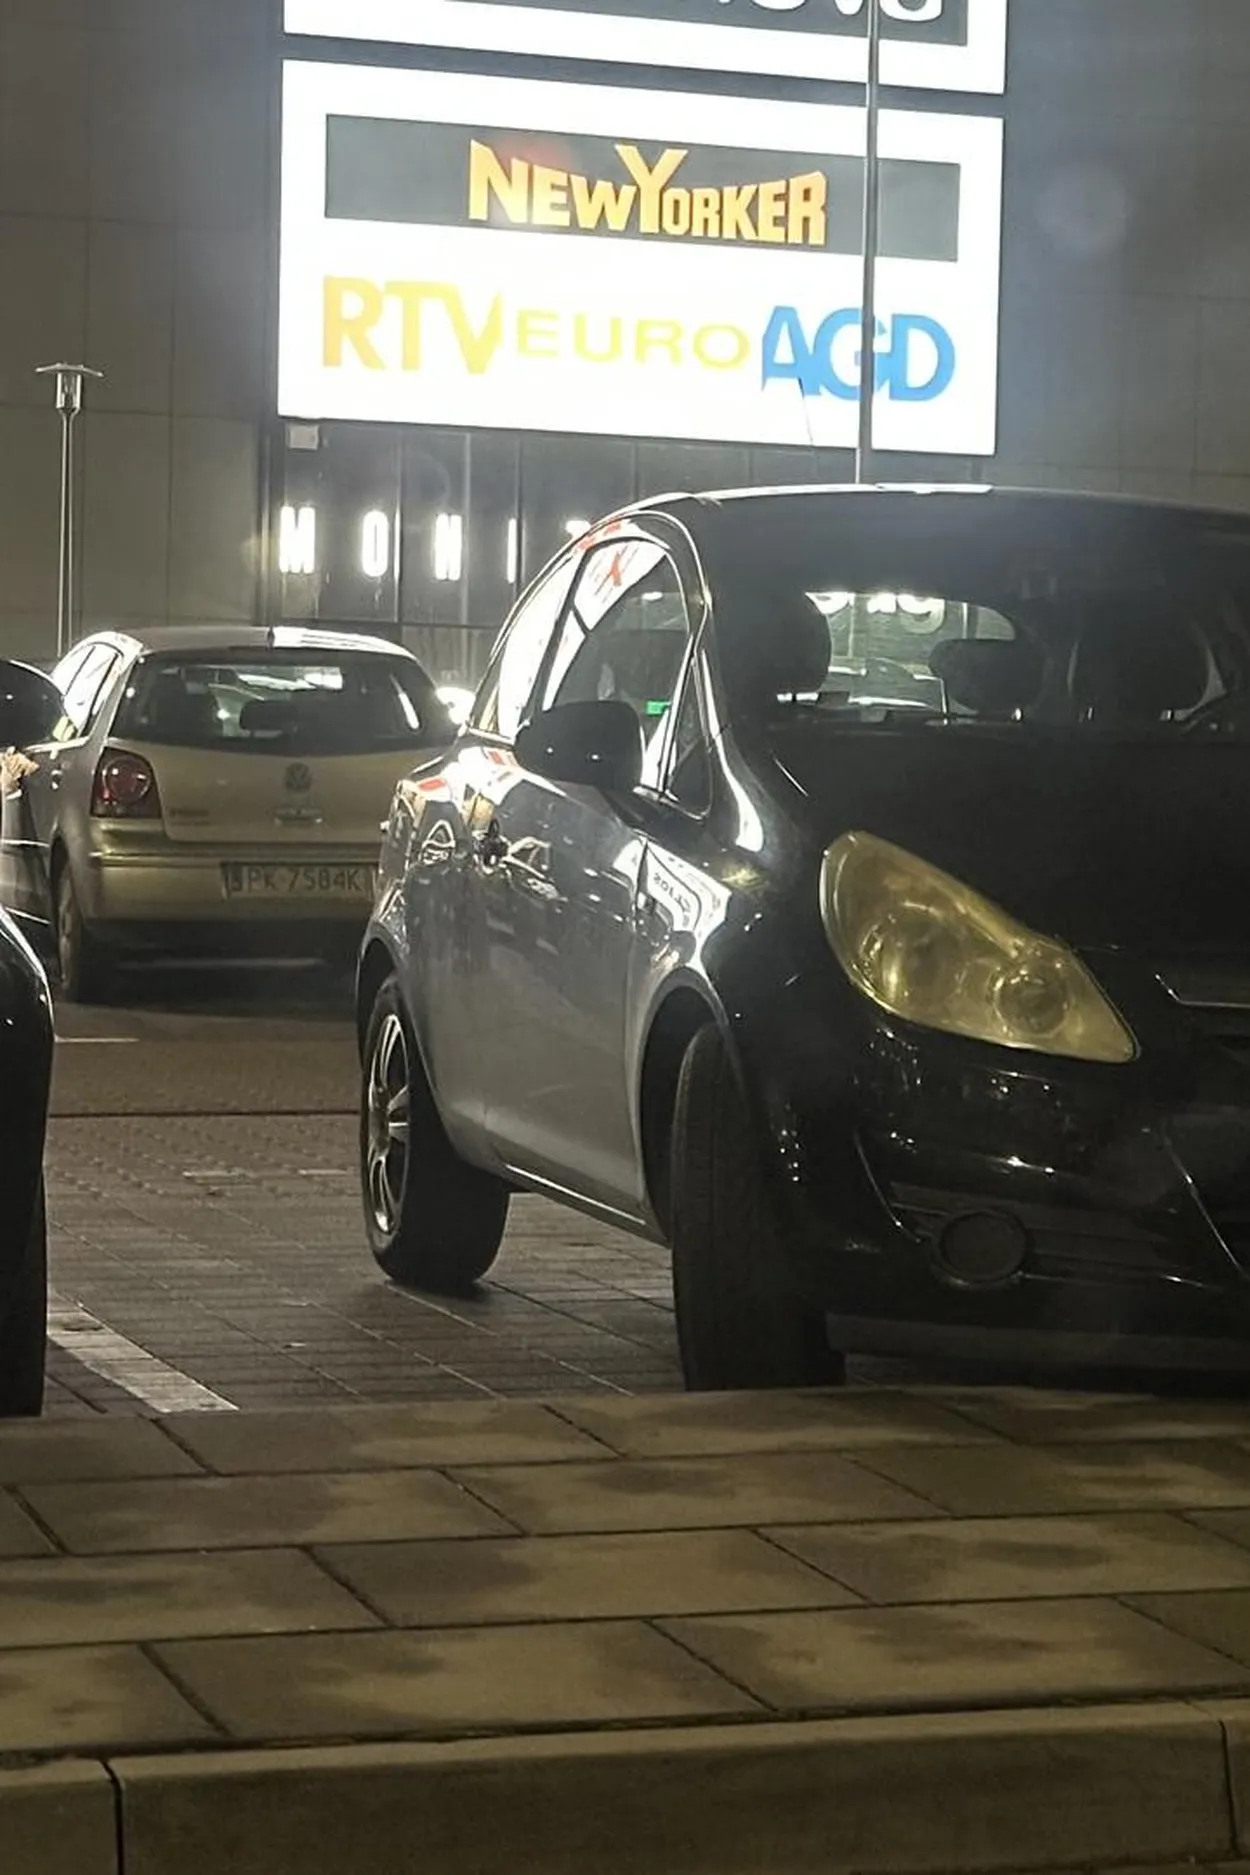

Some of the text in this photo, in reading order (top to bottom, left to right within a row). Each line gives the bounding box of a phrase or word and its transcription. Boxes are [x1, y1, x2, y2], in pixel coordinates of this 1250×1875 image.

[323, 275, 956, 401] RTV EURO AGD
